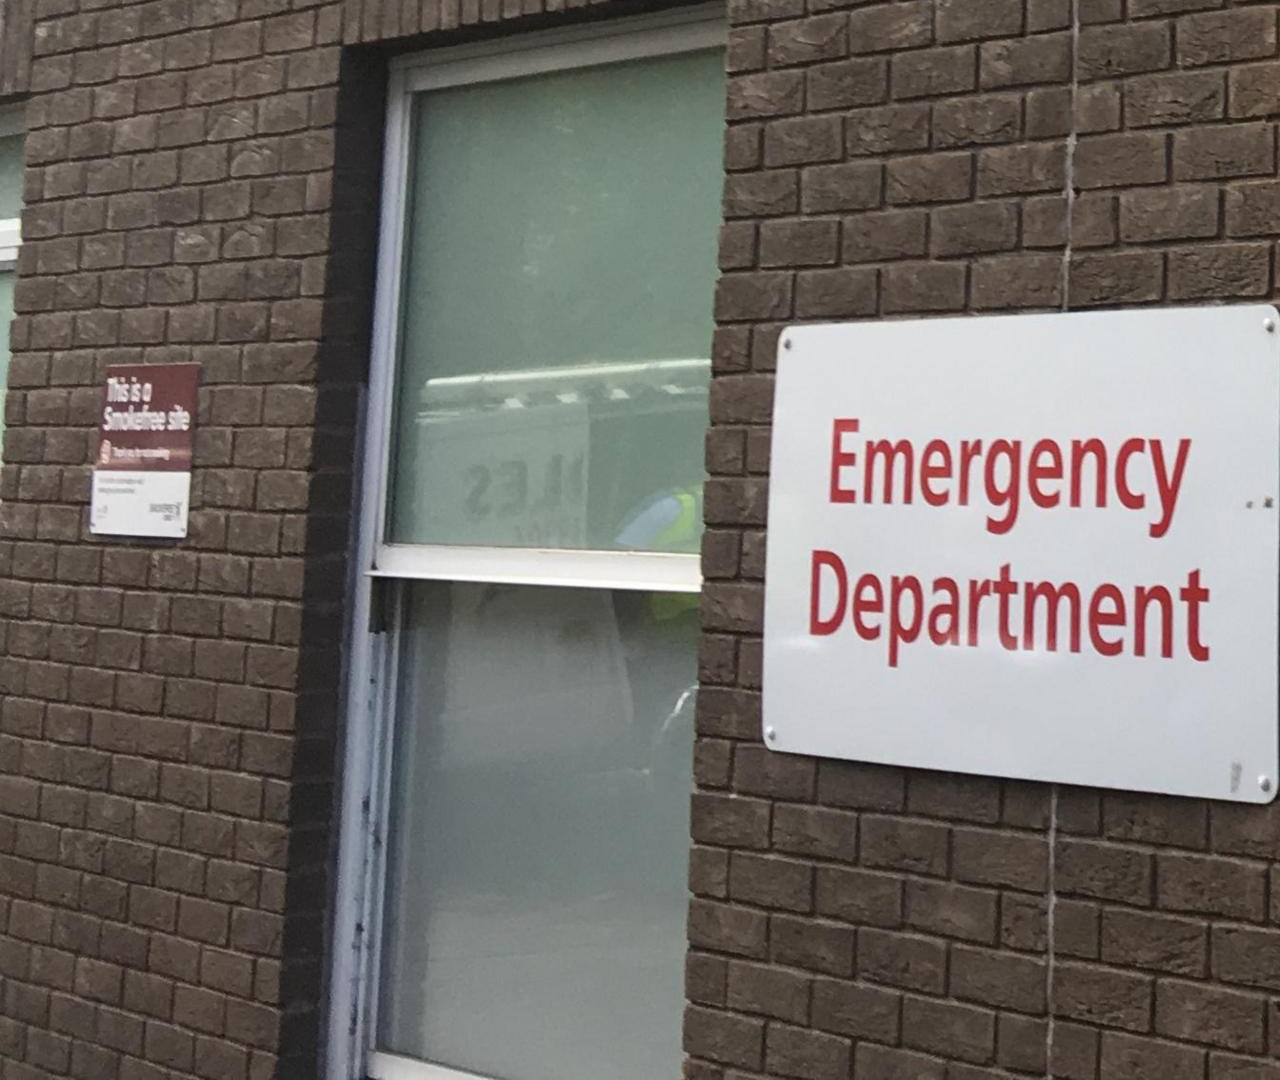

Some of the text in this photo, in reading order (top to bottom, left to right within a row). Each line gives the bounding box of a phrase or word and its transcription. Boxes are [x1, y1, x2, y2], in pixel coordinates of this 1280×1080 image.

[103, 404, 190, 431] Smokefree site
[107, 377, 129, 402] This
[830, 418, 1191, 538] Emergency
[810, 549, 1210, 667] Department
